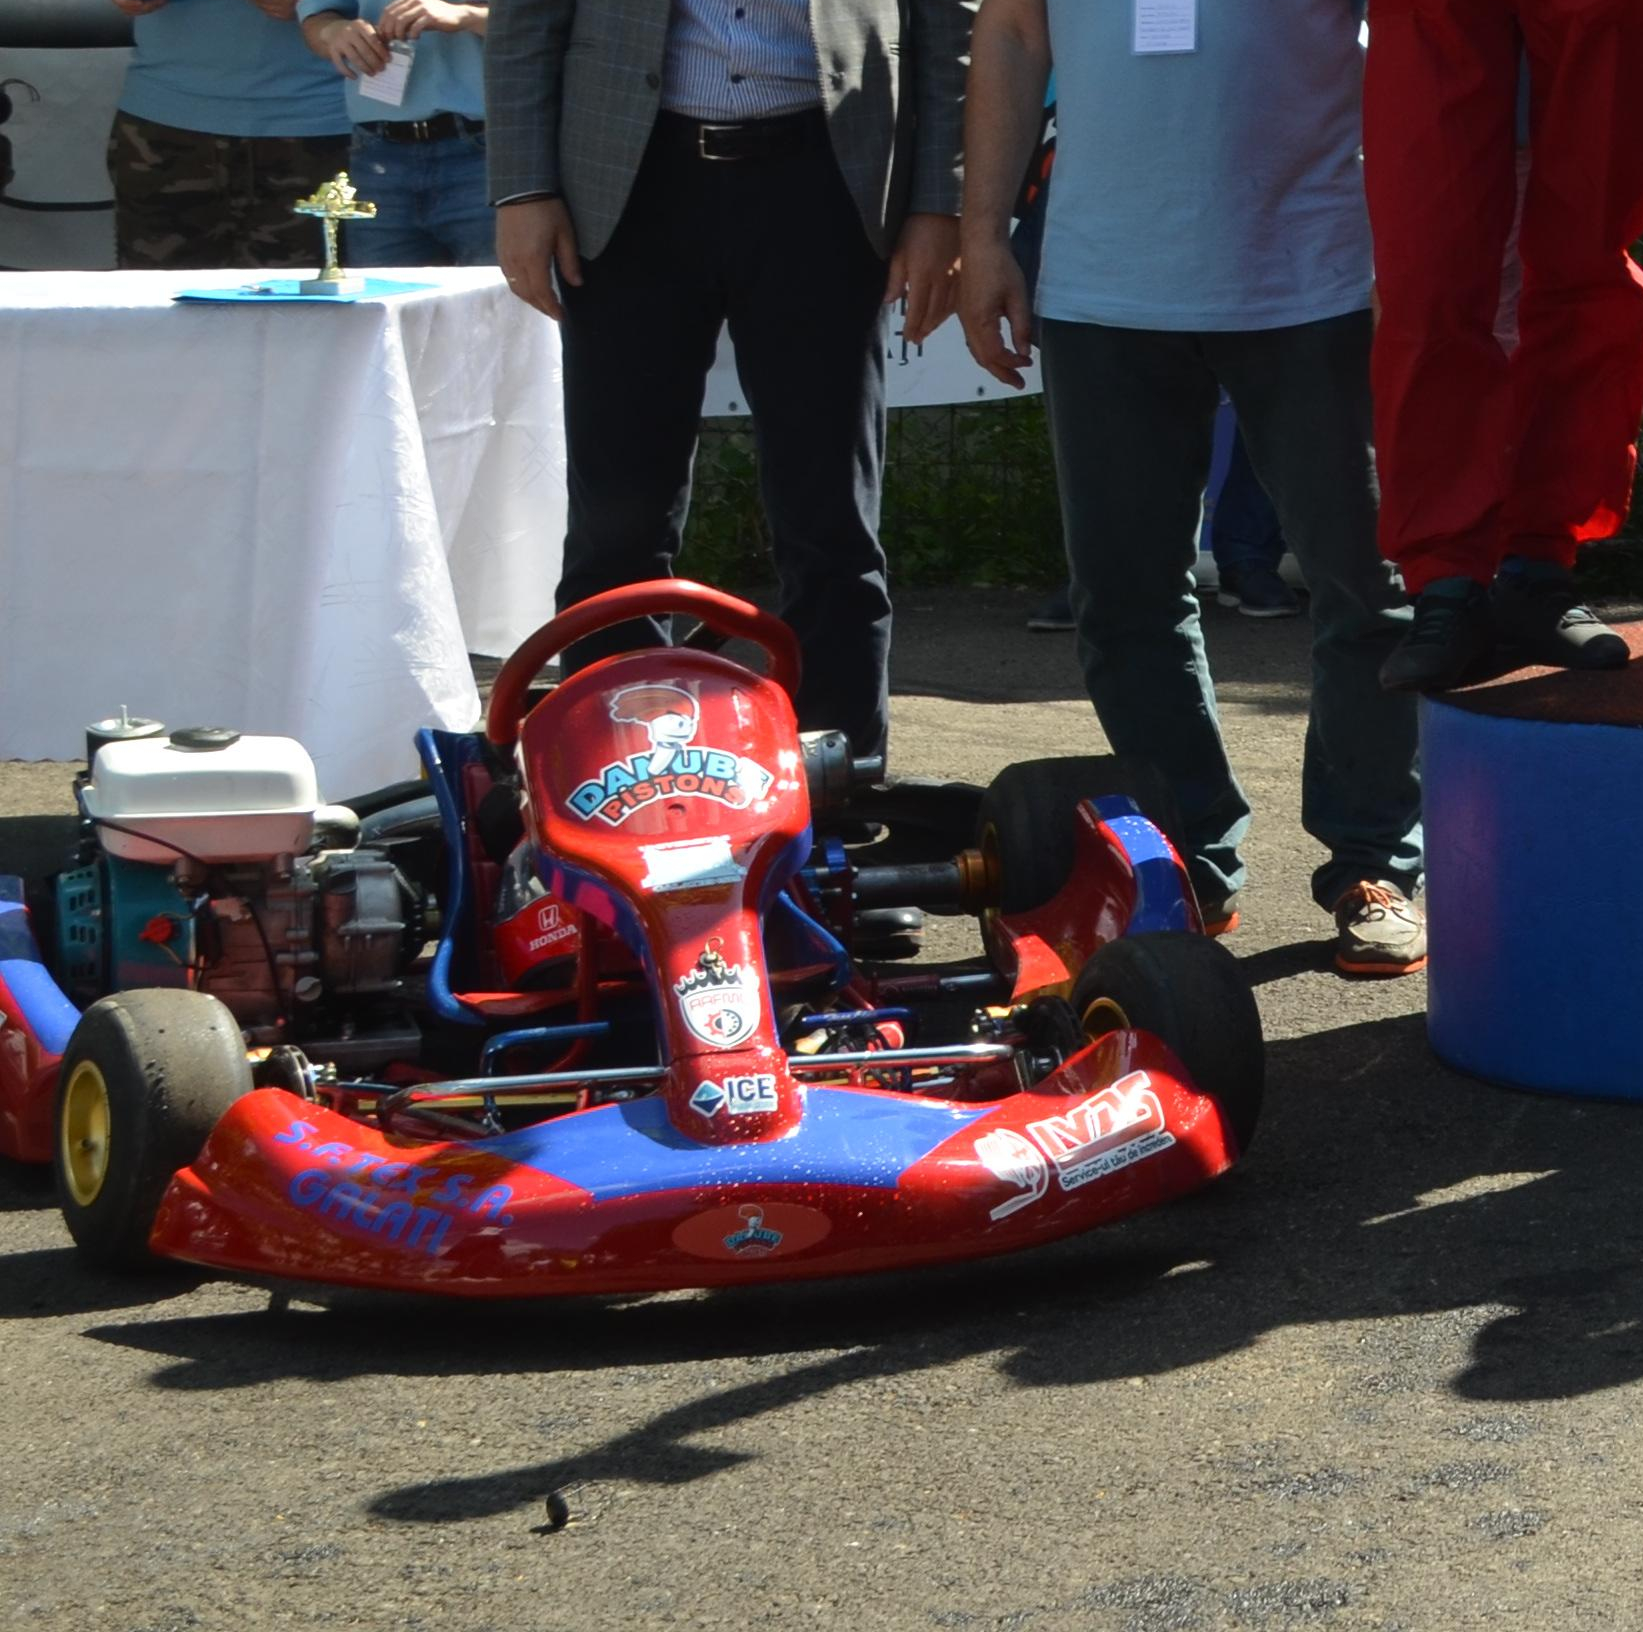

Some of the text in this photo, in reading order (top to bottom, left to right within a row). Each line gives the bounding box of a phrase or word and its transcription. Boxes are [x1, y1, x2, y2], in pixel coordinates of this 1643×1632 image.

[601, 772, 747, 822] PISTONS
[529, 924, 578, 952] HONDA
[727, 1077, 774, 1103] ICE
[289, 1168, 455, 1255] GALATI
